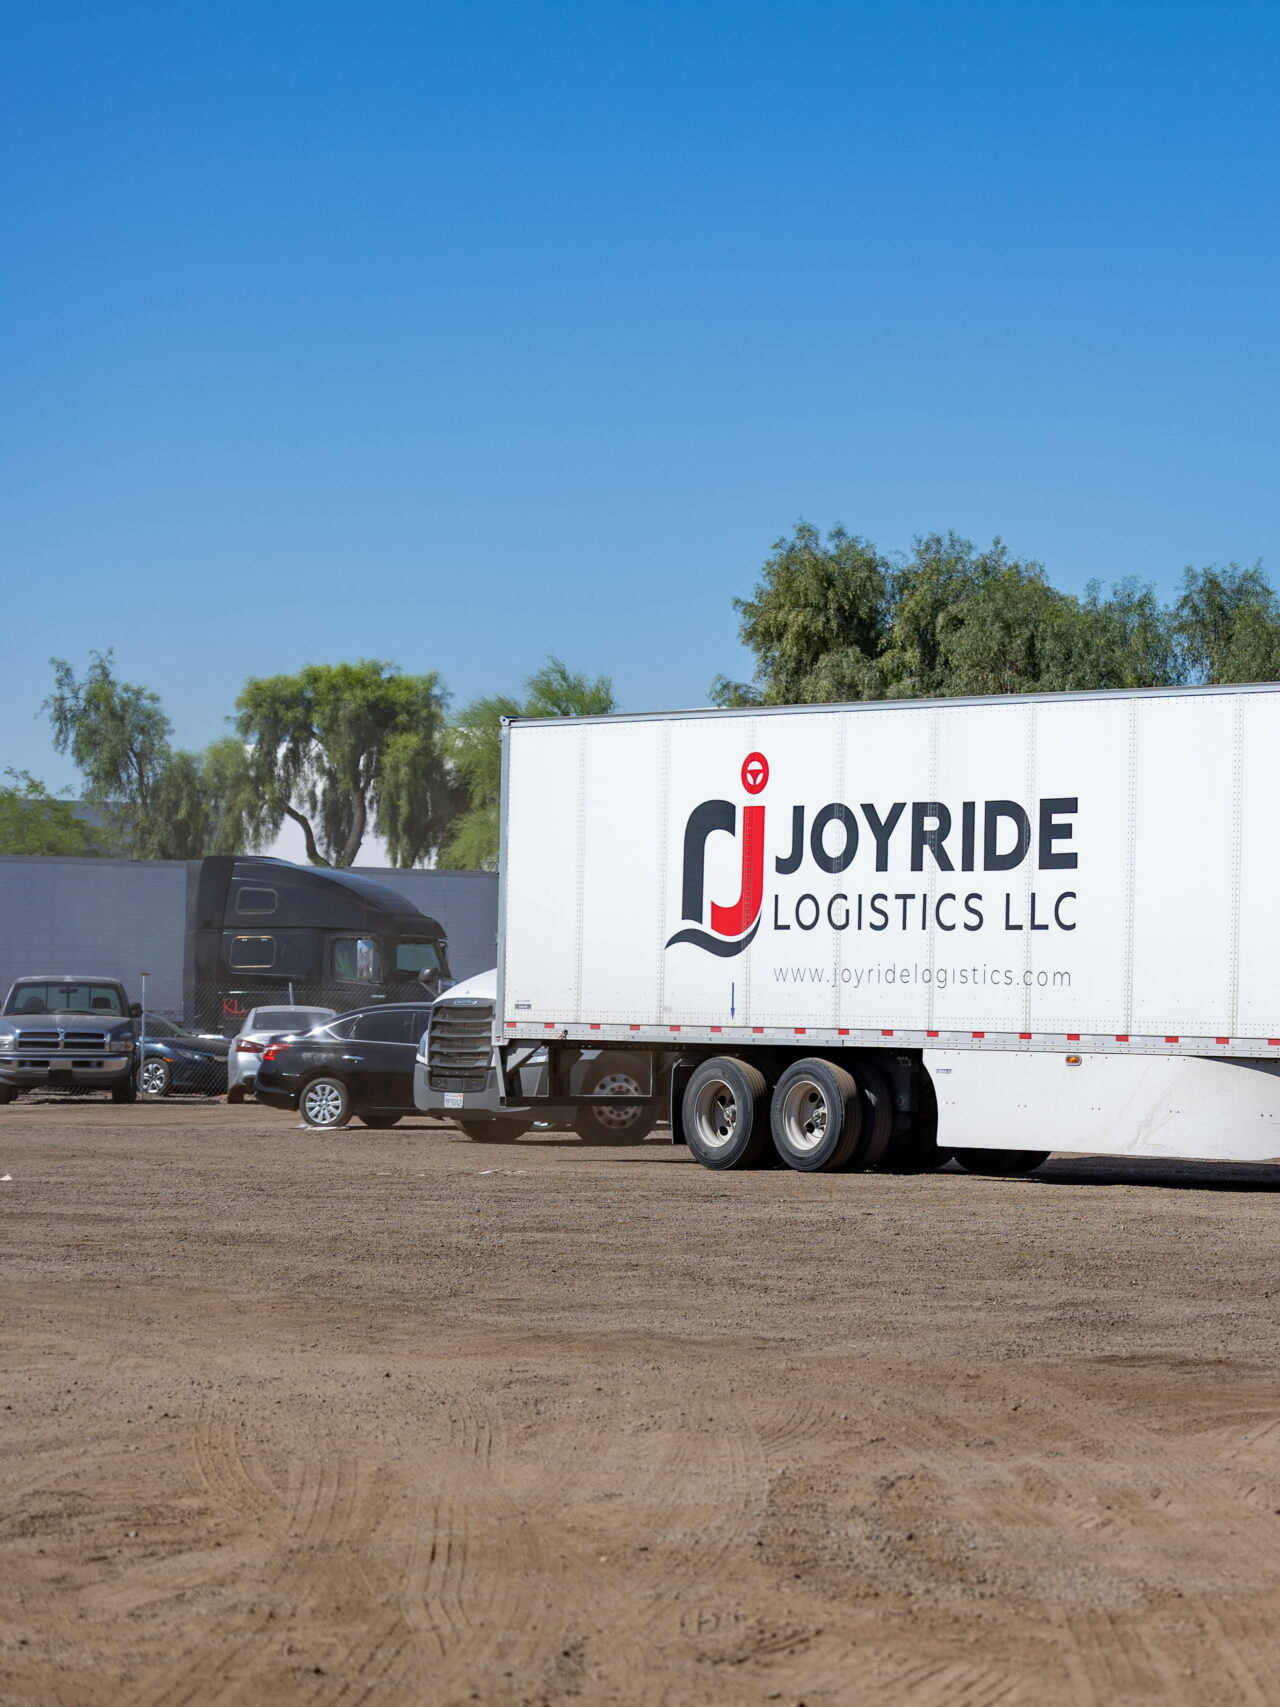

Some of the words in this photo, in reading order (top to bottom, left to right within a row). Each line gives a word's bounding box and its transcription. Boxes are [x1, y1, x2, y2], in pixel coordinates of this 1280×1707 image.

[774, 796, 1079, 875] JOYRIDE
[773, 893, 984, 931] LOGISTICS
[1004, 891, 1077, 931] LLC
[773, 963, 1072, 989] www.joyridelogistics.com
